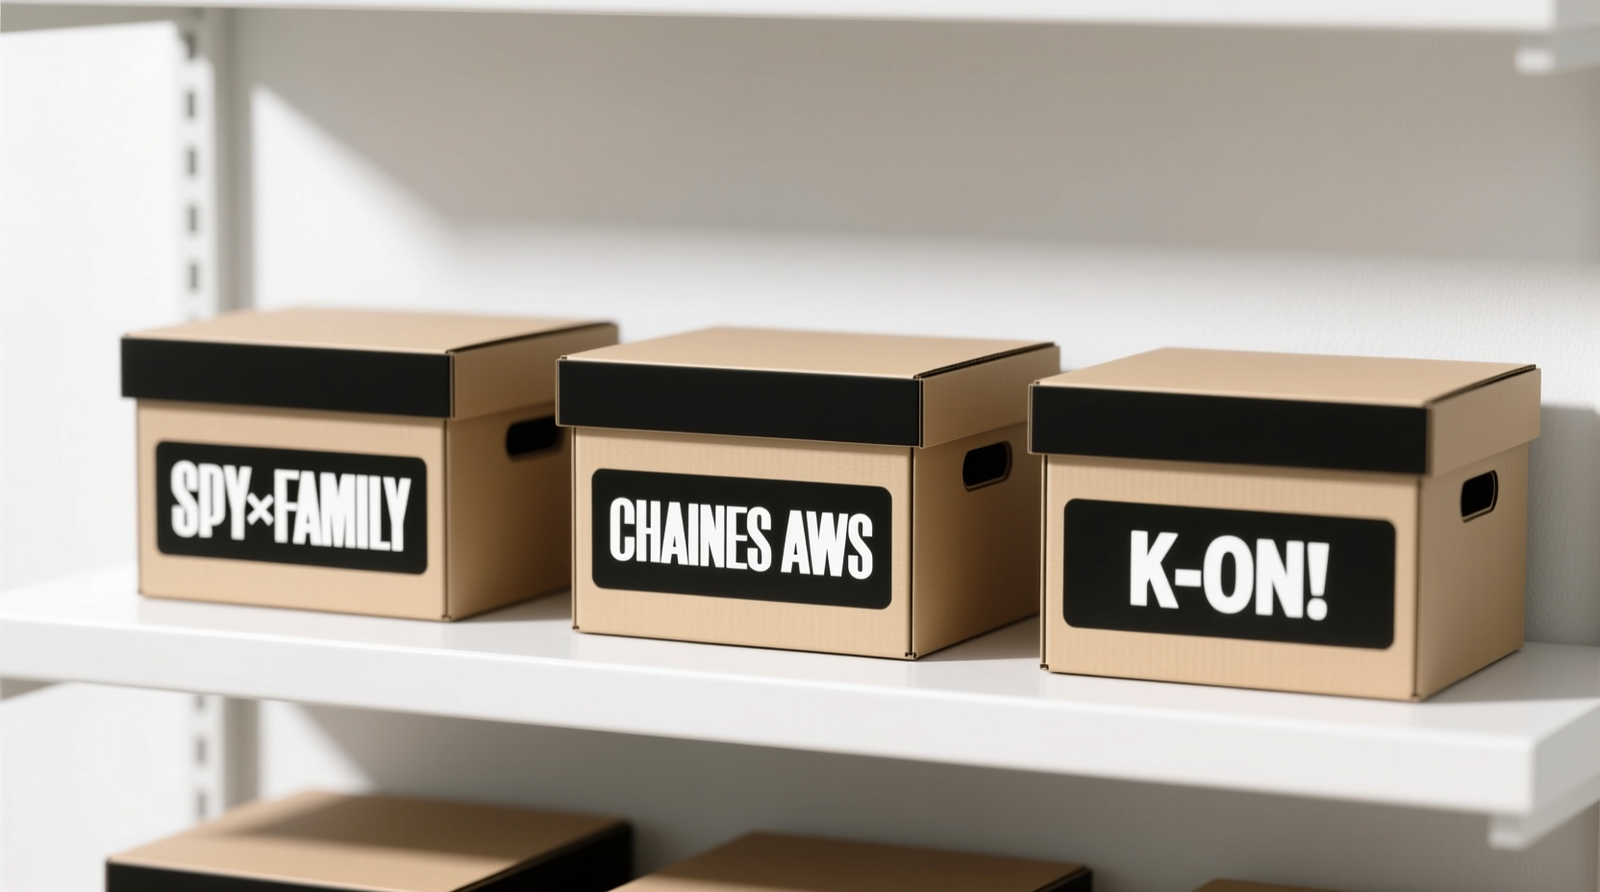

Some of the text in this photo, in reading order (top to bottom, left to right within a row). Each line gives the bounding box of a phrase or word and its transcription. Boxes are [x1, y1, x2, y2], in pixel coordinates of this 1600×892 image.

[609, 497, 874, 580] CHAINES AWS
[1129, 529, 1330, 621] K-ON!
